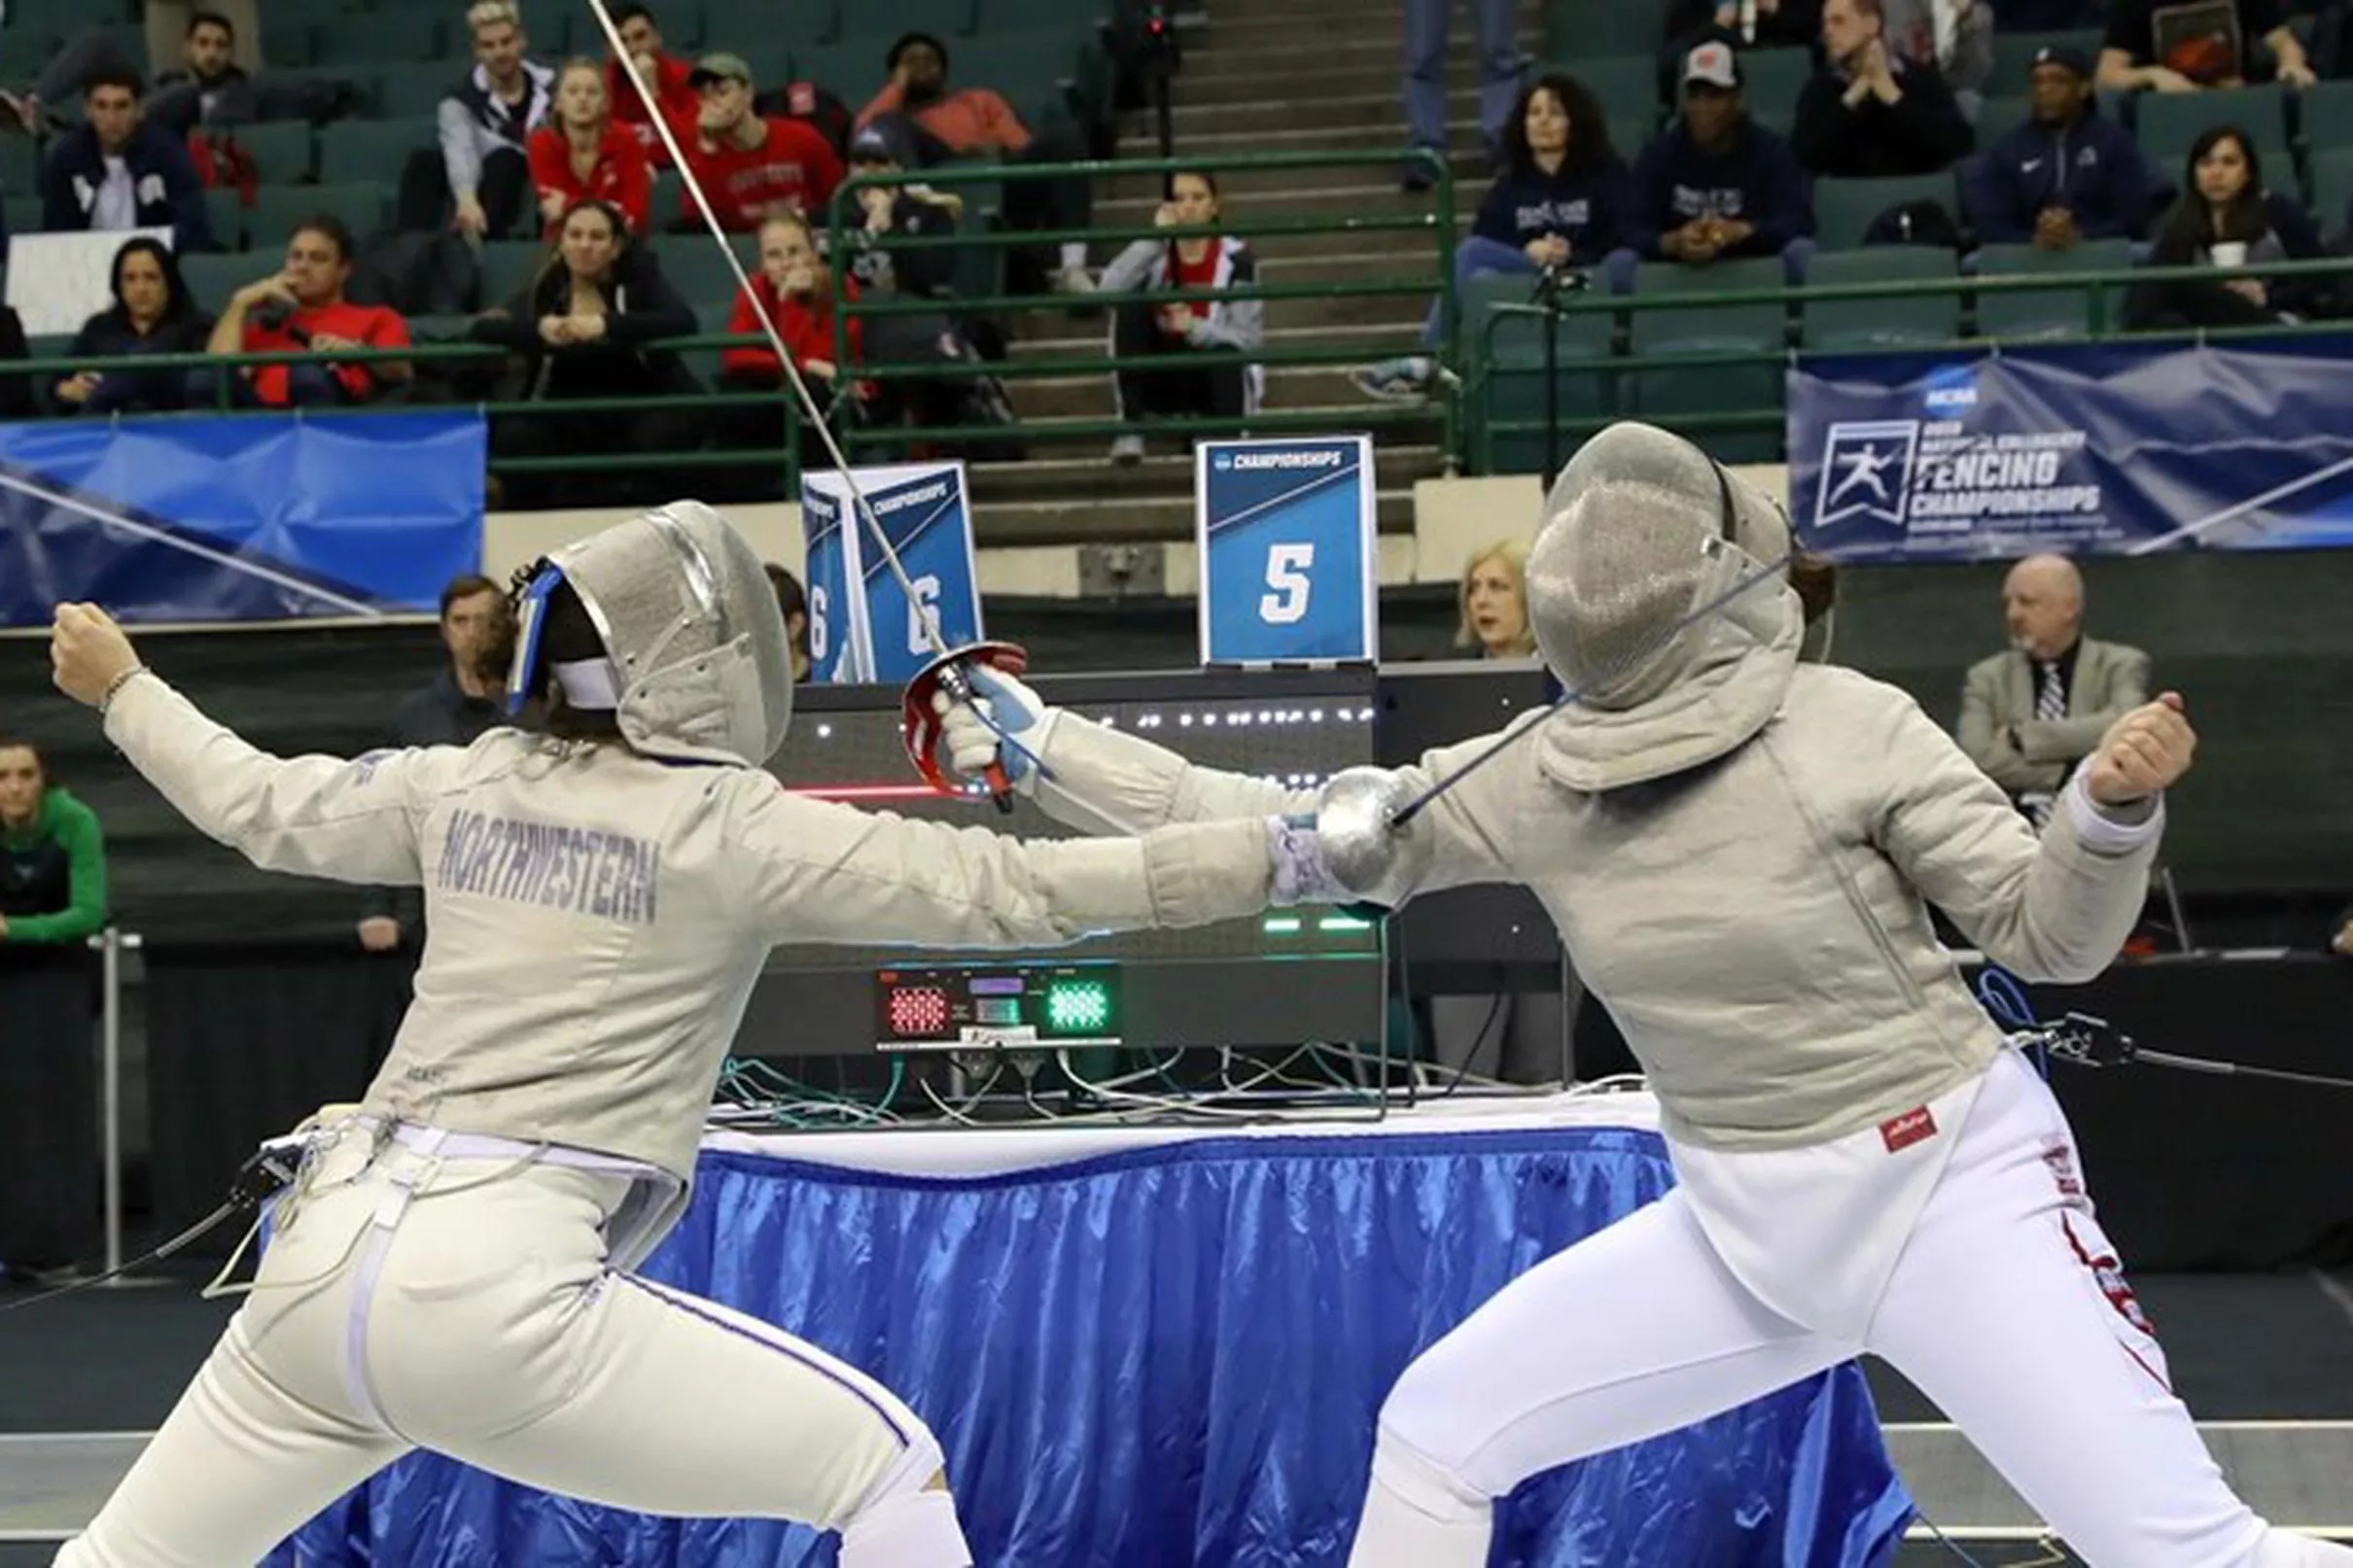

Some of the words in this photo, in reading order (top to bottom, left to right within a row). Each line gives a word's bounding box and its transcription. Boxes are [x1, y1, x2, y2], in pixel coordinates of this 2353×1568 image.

[1233, 451, 1342, 470] CHAMPIONSHIPS
[1915, 450, 2060, 490] FENCING
[874, 482, 947, 515] CHAMPIONSHIPS
[1910, 486, 2101, 516] CHAMPIONSHIPS
[1259, 542, 1314, 623] 5
[810, 585, 826, 660] 6
[908, 575, 940, 655] 6
[438, 808, 661, 925] NORTHWESTERN
